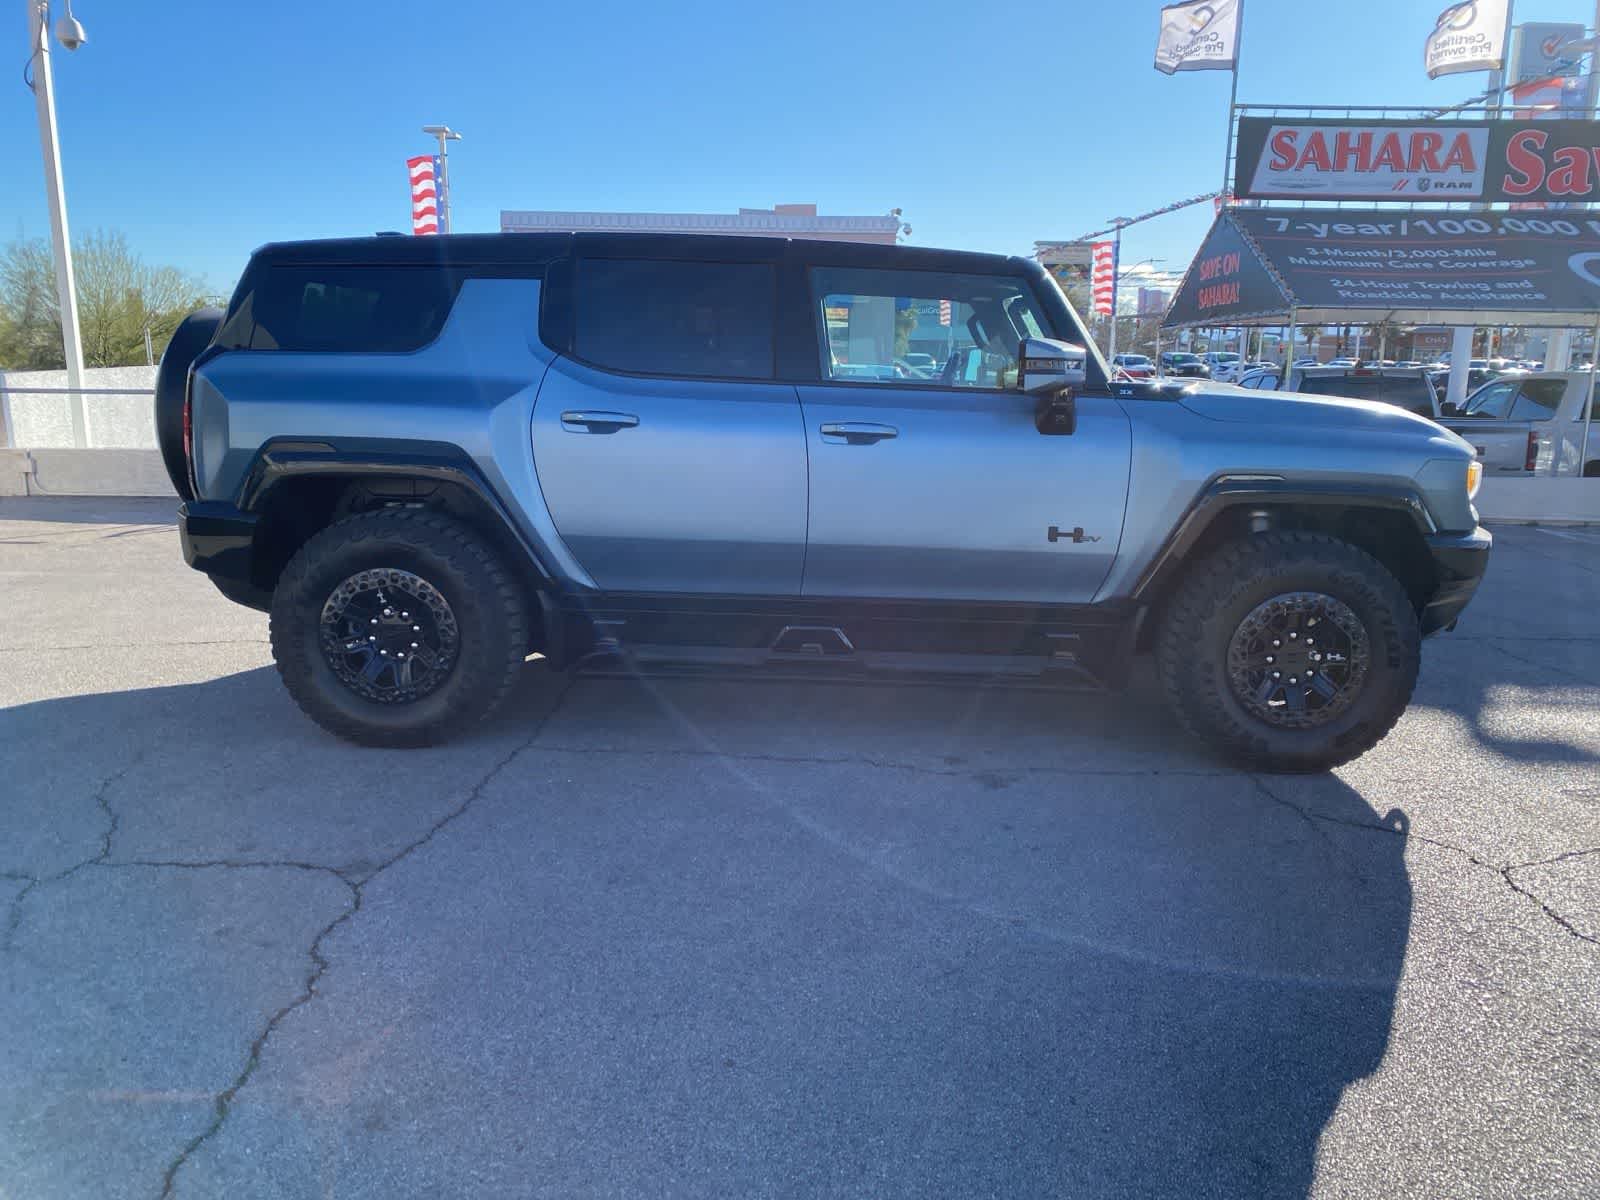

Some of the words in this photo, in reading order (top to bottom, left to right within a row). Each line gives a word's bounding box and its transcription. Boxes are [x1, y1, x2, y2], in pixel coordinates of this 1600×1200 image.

[1269, 129, 1477, 173] SAHARA
[1502, 129, 1600, 196] Sa
[1434, 181, 1473, 189] RAM
[1223, 251, 1240, 276] ON
[1288, 256, 1384, 269] Maximum
[1388, 259, 1434, 269] Care
[1439, 258, 1537, 269] Coverage
[1329, 278, 1410, 290] 24-Hour
[1413, 280, 1491, 291] Towing
[1495, 279, 1534, 290] and
[1336, 289, 1433, 300] Roadside
[1440, 291, 1547, 301] Assistance
